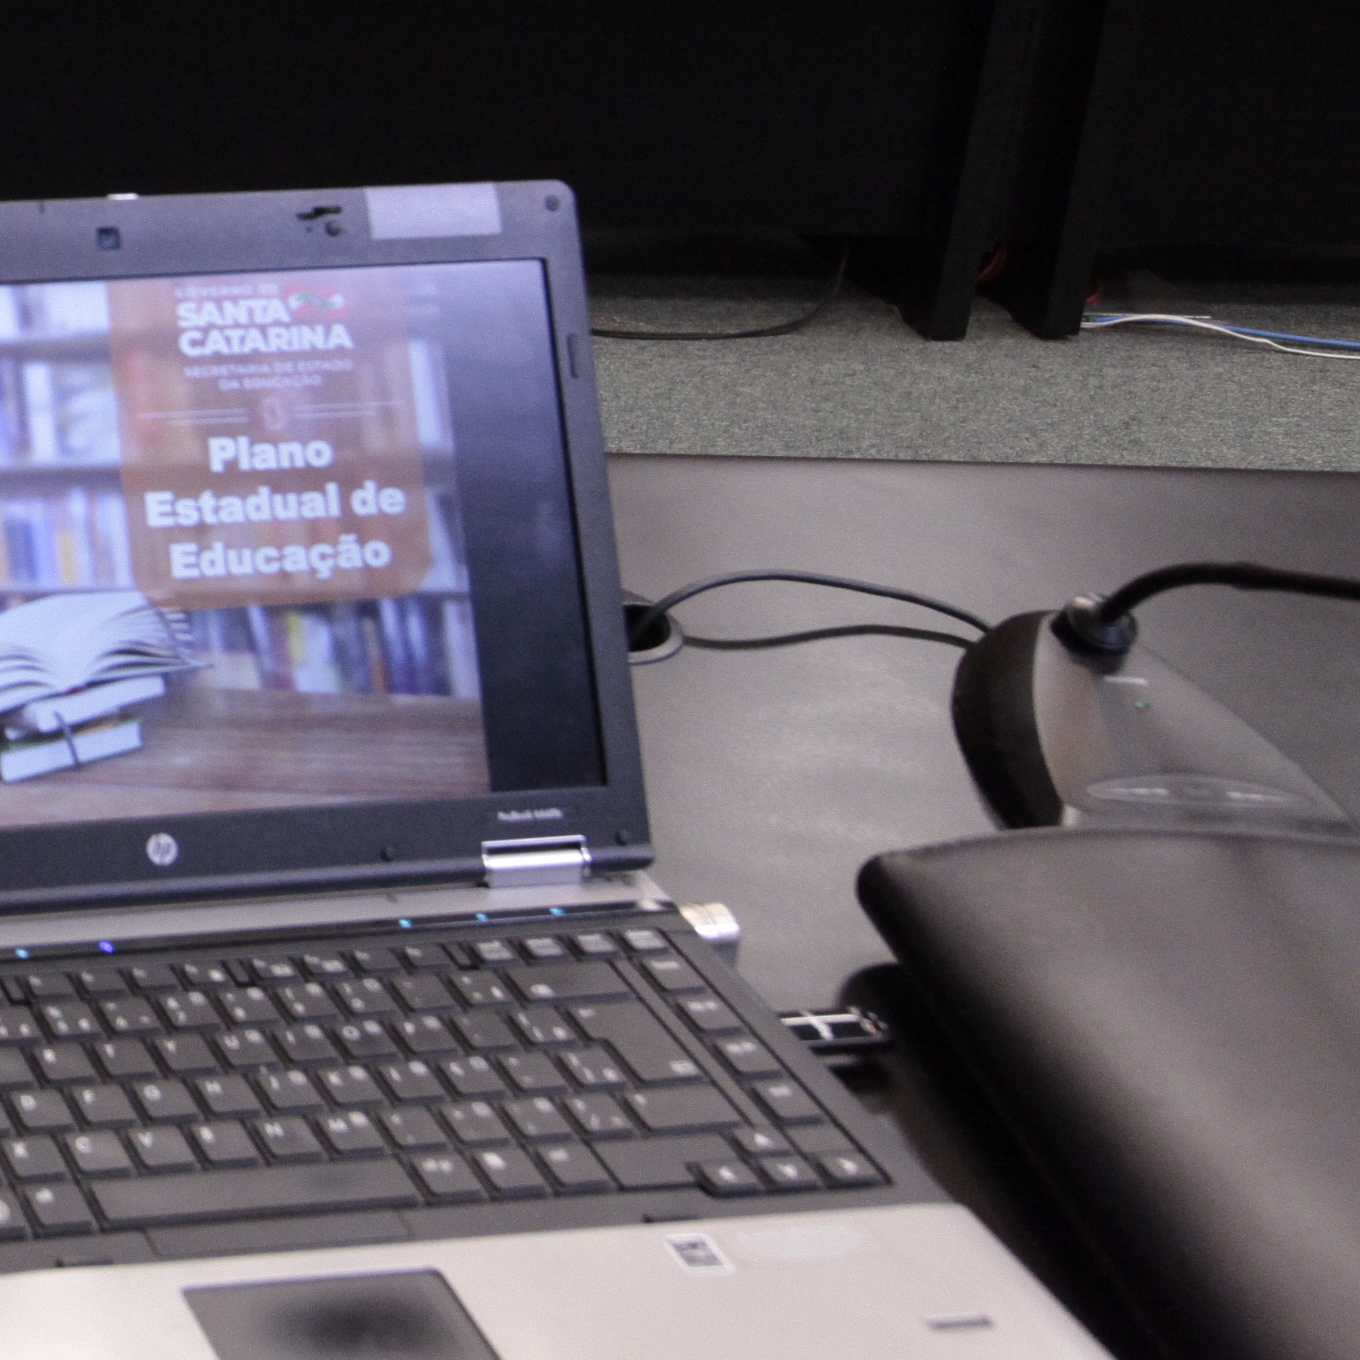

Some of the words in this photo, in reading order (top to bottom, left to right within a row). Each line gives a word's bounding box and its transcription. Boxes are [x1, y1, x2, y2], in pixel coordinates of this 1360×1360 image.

[177, 298, 293, 328] SANTA
[179, 323, 357, 357] CATARINA
[208, 436, 334, 473] Plano
[145, 482, 342, 528] Estadual
[350, 479, 407, 516] de
[170, 533, 392, 579] Educação
